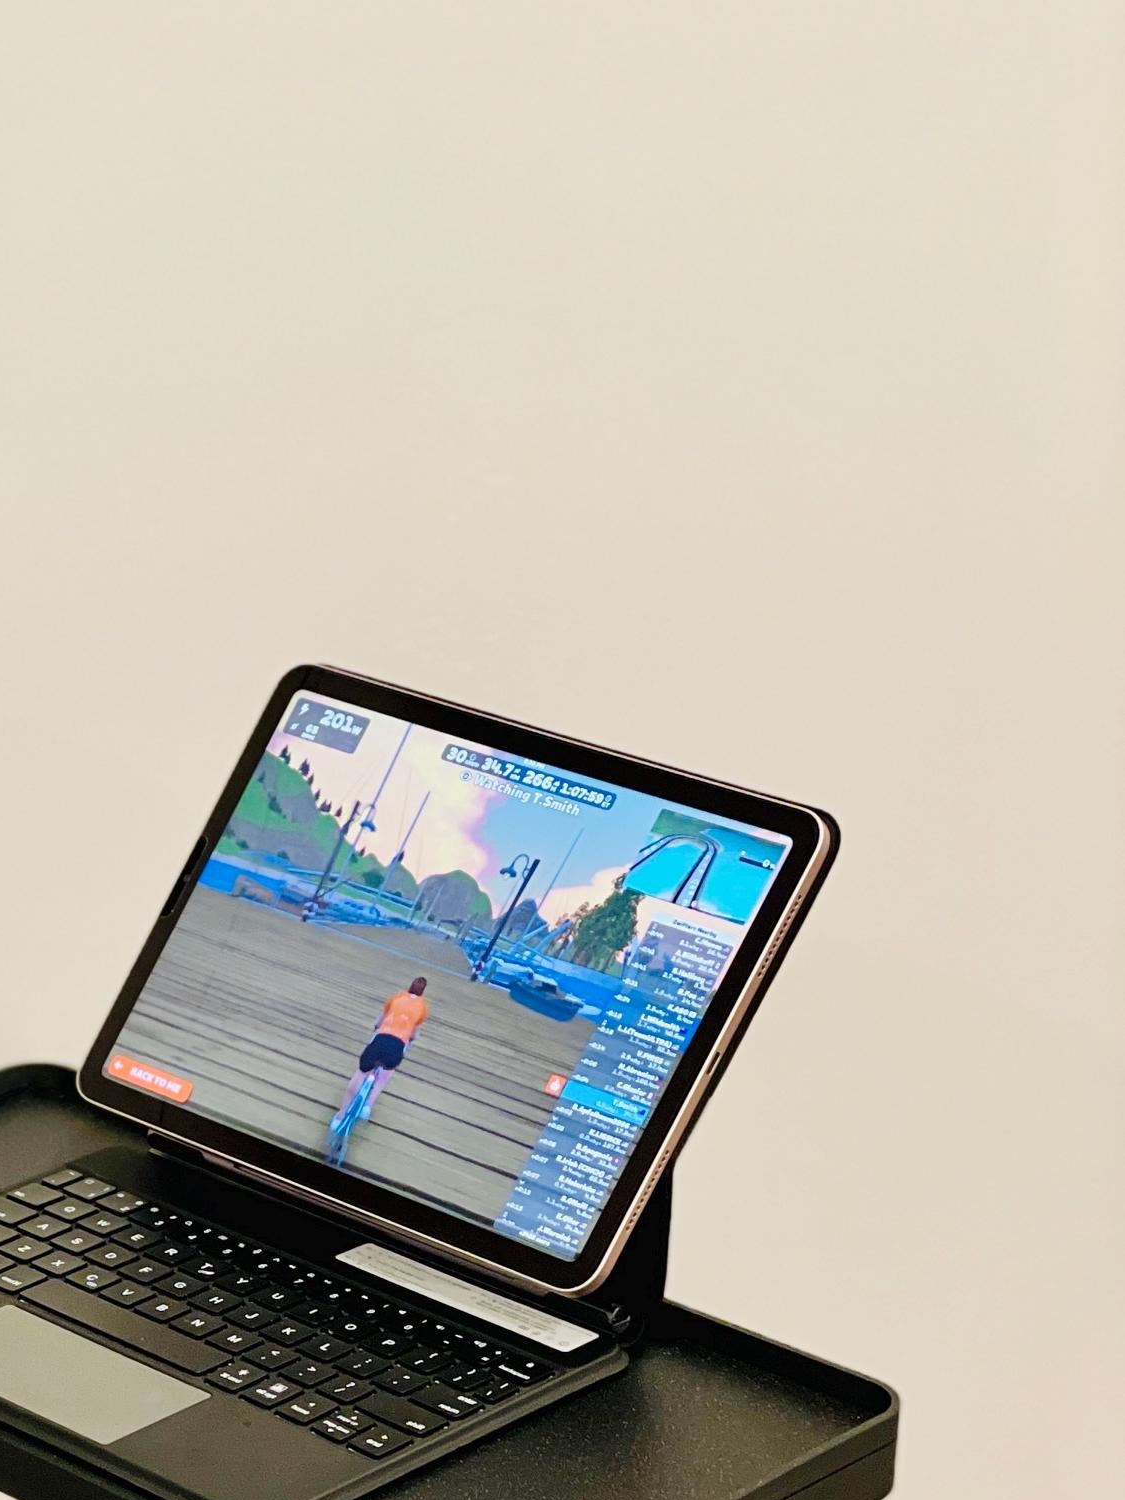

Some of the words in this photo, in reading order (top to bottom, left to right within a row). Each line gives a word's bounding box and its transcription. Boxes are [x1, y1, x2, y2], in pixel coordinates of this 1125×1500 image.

[474, 774, 530, 803] Watching
[533, 792, 581, 816] T.Smith
[481, 757, 515, 778] 34.7
[17, 1245, 32, 1253] Z
[50, 1259, 66, 1267] X
[122, 1288, 135, 1296] V
[190, 1318, 206, 1327] N
[226, 1334, 243, 1344] M
[36, 1223, 49, 1231] A
[70, 1237, 84, 1245] S
[173, 1281, 187, 1289] G
[208, 1296, 224, 1305] H
[244, 1312, 260, 1320] J
[281, 1327, 297, 1336] K
[319, 1342, 331, 1352] L
[96, 1219, 111, 1227] W
[130, 1233, 145, 1242] E
[163, 1247, 179, 1256] R
[200, 1262, 214, 1270] T
[236, 1277, 250, 1285] Y
[271, 1292, 285, 1300] U
[344, 1323, 358, 1331] O
[381, 1338, 396, 1346] P
